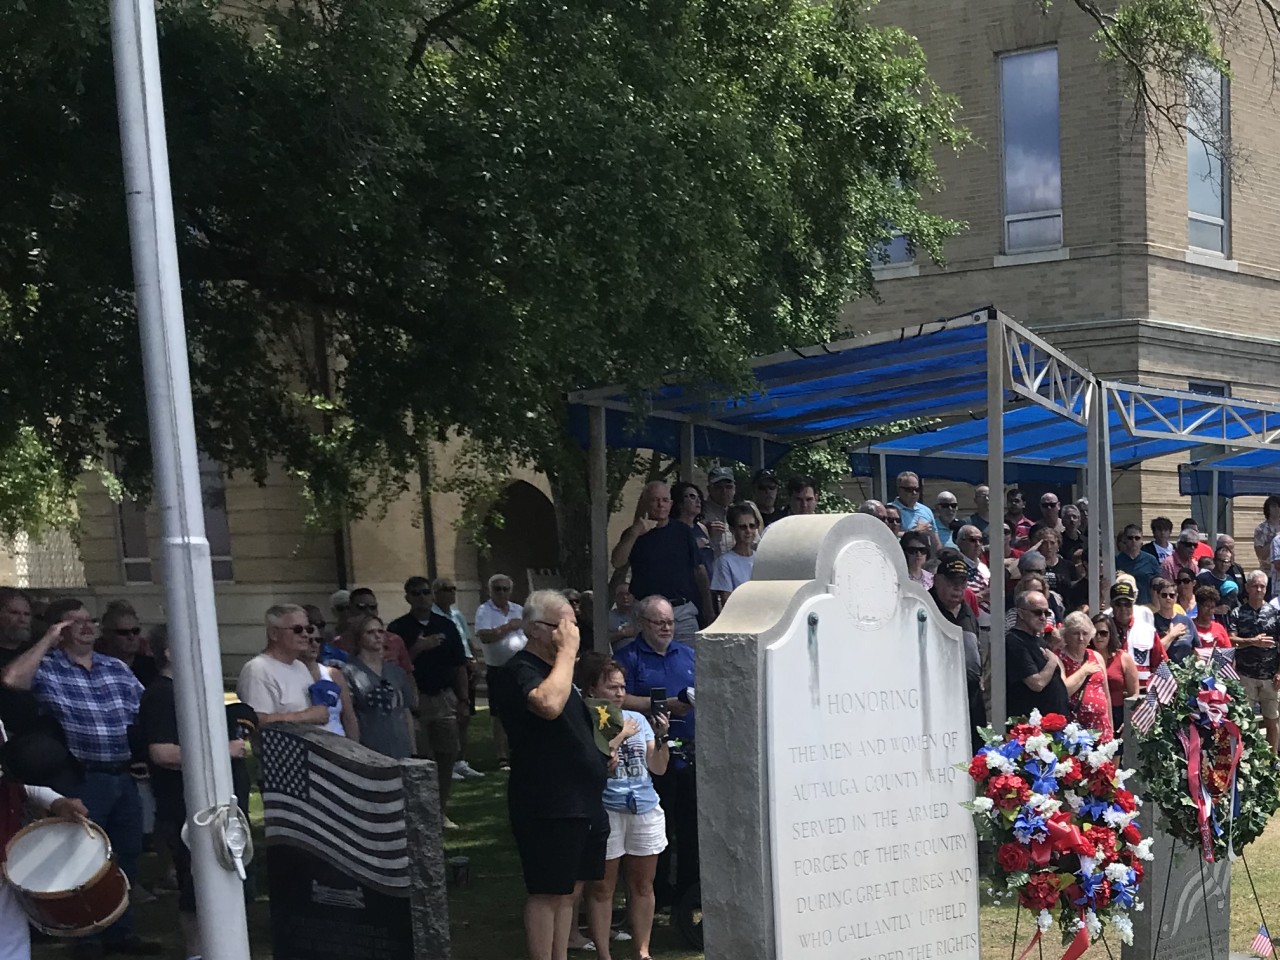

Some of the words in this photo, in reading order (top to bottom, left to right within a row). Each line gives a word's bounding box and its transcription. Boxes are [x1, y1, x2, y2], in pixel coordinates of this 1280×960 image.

[827, 689, 919, 715] HONORING
[789, 747, 817, 764] THE
[822, 742, 852, 761] MEN
[858, 738, 886, 757] AND
[890, 733, 938, 752] WOMEN
[942, 731, 958, 749] OF
[792, 778, 859, 801] AUTAUGA
[865, 771, 921, 792] COUNTY
[927, 767, 956, 785] WHO
[792, 817, 846, 840] SERVED
[853, 814, 866, 831] IN
[873, 809, 898, 828] THE
[906, 802, 949, 823] ARMED
[794, 852, 848, 876] FORCES
[853, 849, 870, 867] OF
[876, 844, 911, 863] THEIR
[914, 833, 970, 857] COUNTRY
[796, 889, 853, 914] DURING
[856, 880, 899, 904] GREAT
[902, 872, 944, 895] CRISES
[949, 867, 973, 884] AND
[798, 929, 832, 949] WHO
[838, 912, 914, 943] GALLANTLY
[919, 902, 967, 926] UPHELD
[936, 932, 977, 956] RIGHTS
